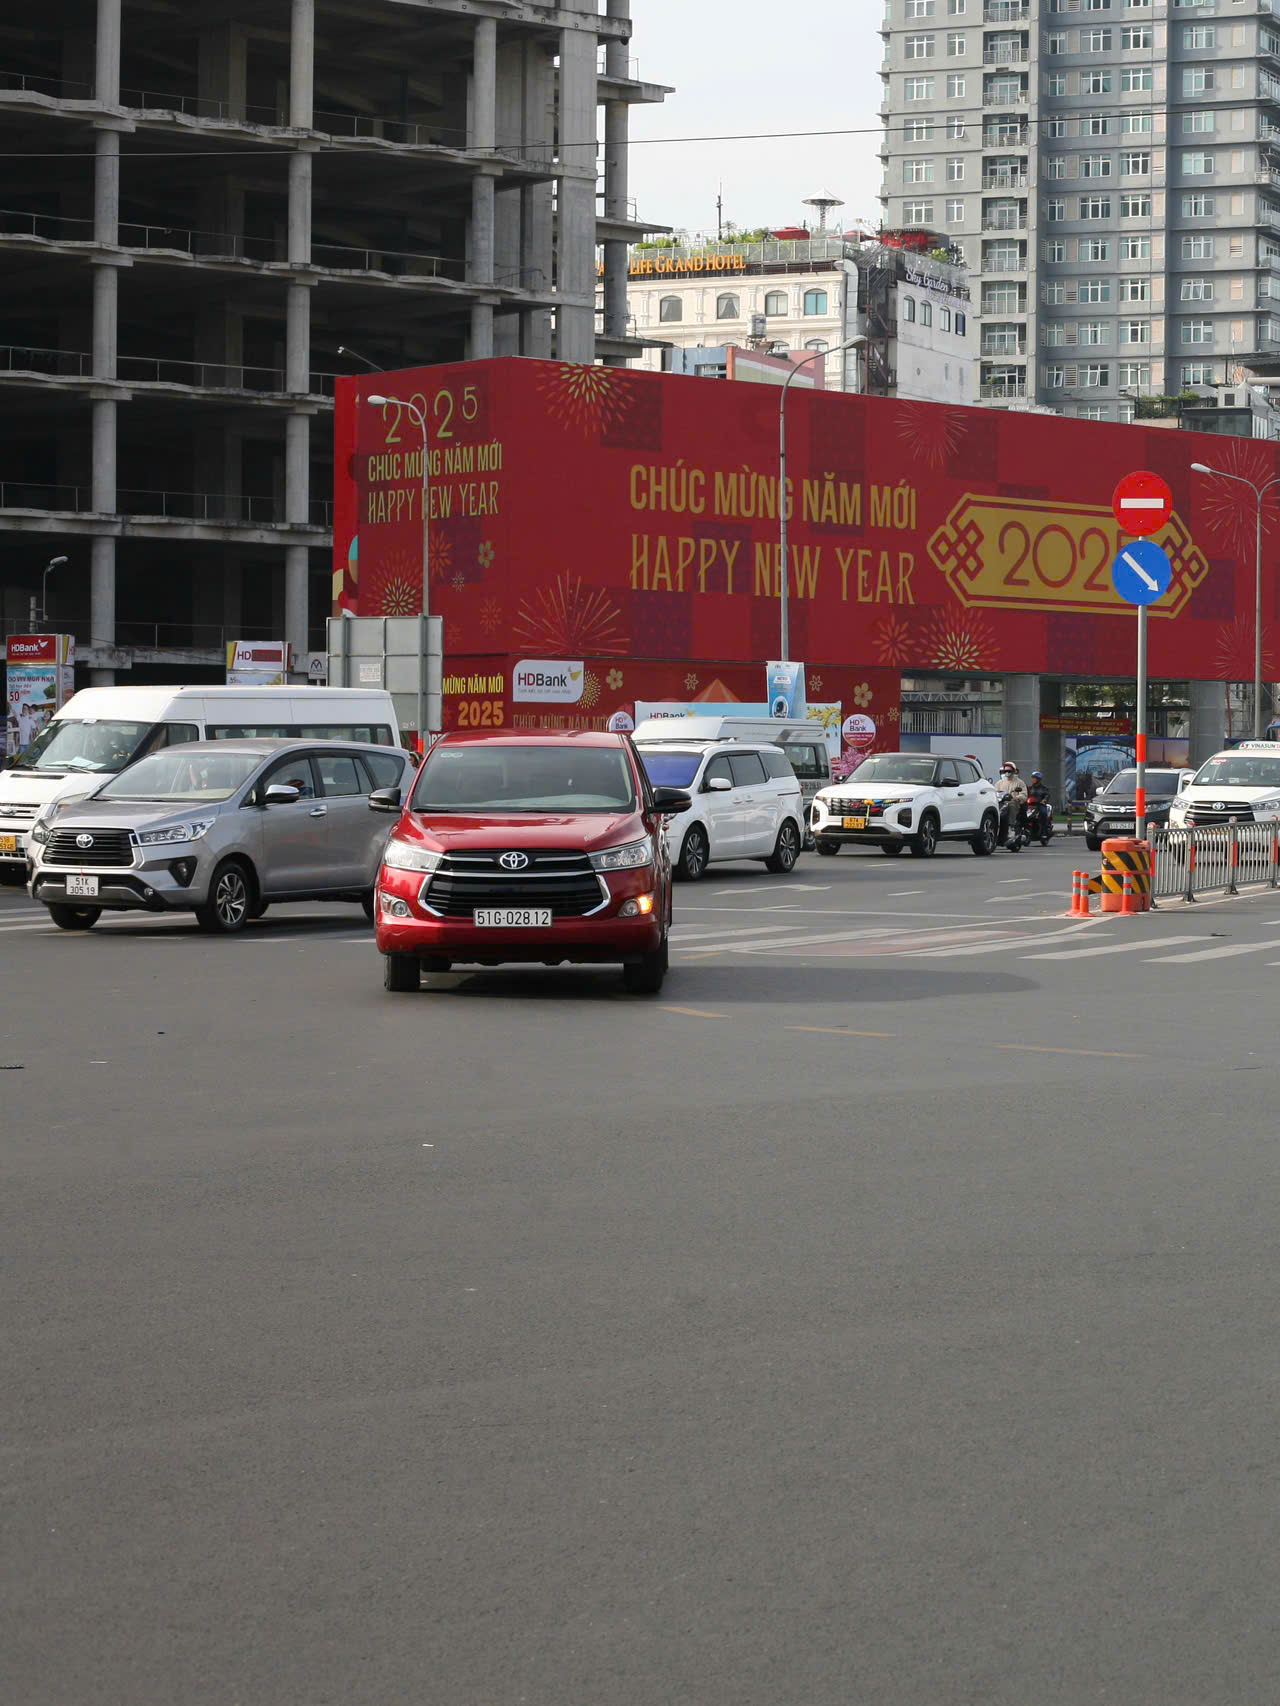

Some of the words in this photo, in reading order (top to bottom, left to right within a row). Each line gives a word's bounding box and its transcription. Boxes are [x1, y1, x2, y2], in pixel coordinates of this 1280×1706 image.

[629, 259, 652, 275] LIFE
[655, 256, 704, 273] GRAND
[705, 253, 746, 271] HOTEL
[906, 266, 921, 287] Sky
[923, 271, 948, 292] Garden
[382, 386, 478, 444] 2025
[368, 449, 401, 482] CHÚC
[404, 446, 441, 479] MỪNG
[444, 442, 474, 475] NĂM
[477, 438, 502, 472] MỚI
[368, 488, 415, 524] HAPPY
[459, 481, 499, 517] YEAR
[630, 458, 706, 514] CHÚC
[714, 464, 793, 521] MỪNG
[802, 471, 861, 526] NĂM
[870, 479, 917, 530] MỚI
[998, 520, 1140, 591] 202
[629, 534, 741, 595] HAPPY
[754, 542, 822, 600] NEW
[835, 547, 916, 605] YEAR
[11, 643, 39, 652] HDBank
[442, 674, 466, 694] MỪNG
[467, 673, 486, 693] NĂM
[488, 672, 504, 693] MỚI
[518, 672, 567, 687] HDBank
[10, 691, 20, 701] 50
[457, 701, 504, 726] 2025
[70, 887, 96, 895] 305.19
[75, 877, 89, 886] 51K
[477, 911, 549, 925] 51G-028.12
